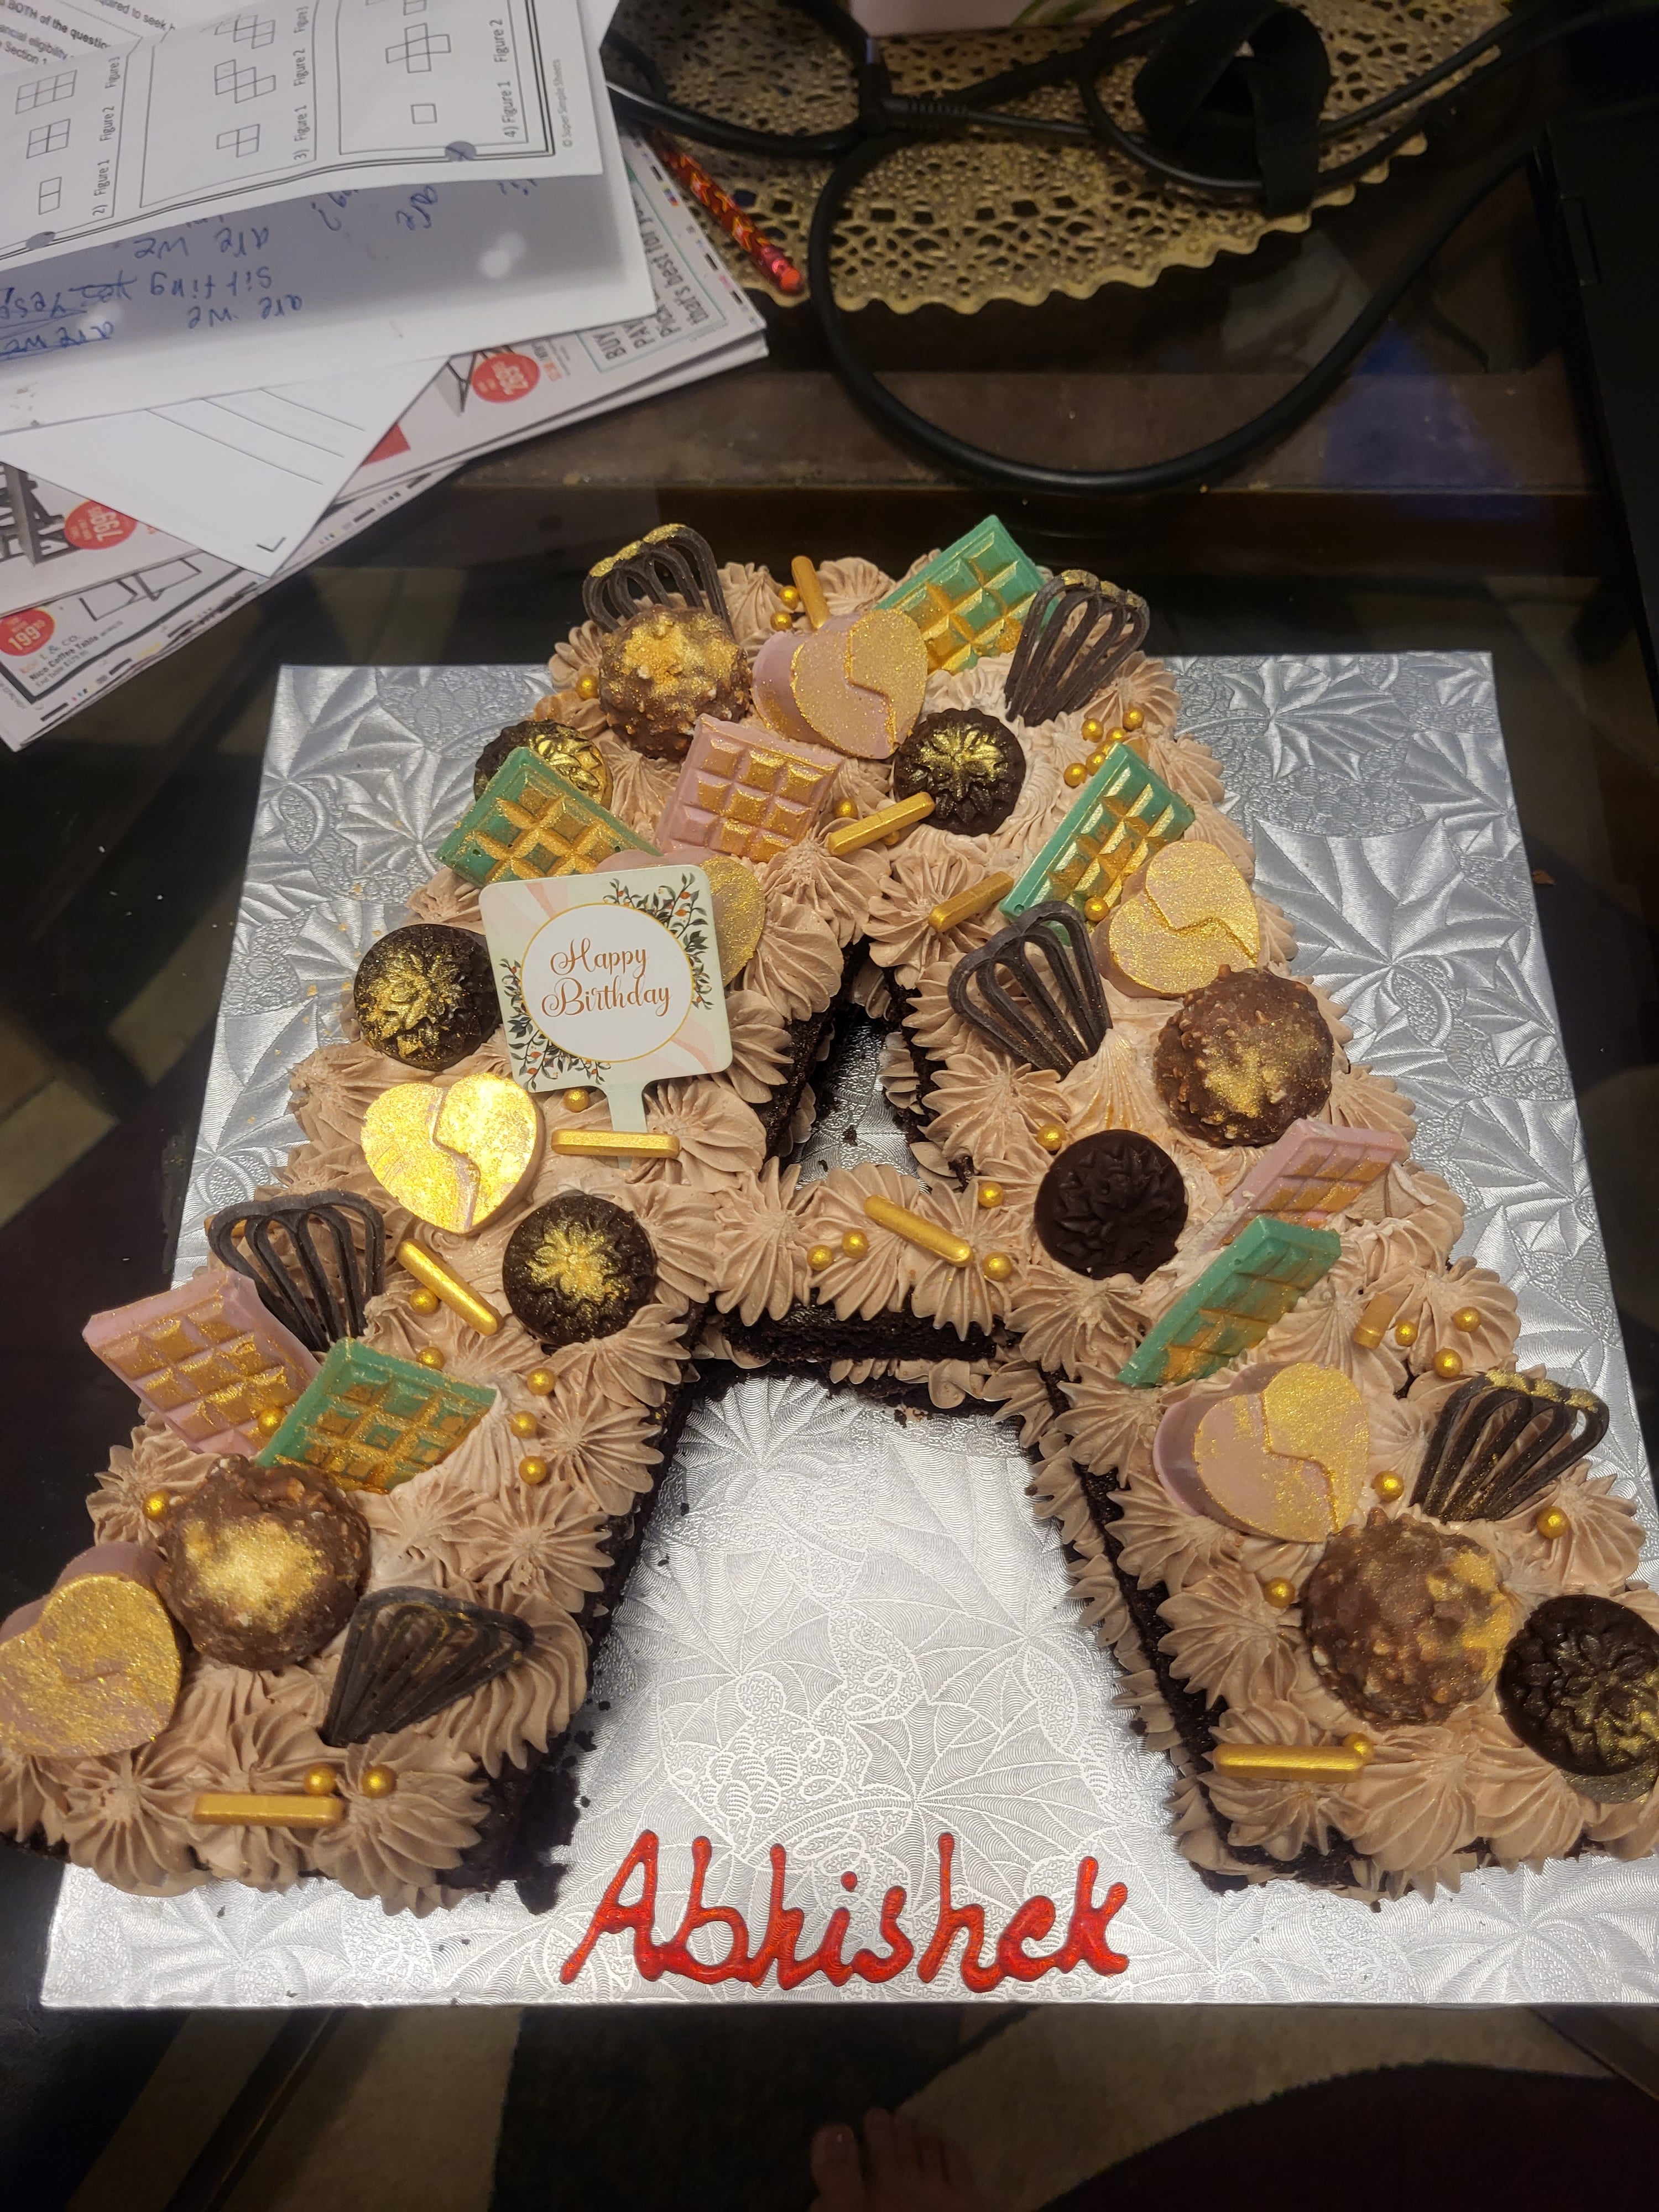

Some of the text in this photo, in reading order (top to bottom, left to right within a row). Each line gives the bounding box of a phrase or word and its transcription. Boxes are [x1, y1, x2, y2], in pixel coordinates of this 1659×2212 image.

[8, 0, 38, 19] BOTH
[40, 15, 51, 25] of
[53, 19, 67, 33] the
[132, 8, 141, 19] to
[143, 14, 166, 30] seek
[4, 41, 39, 65] Section
[489, 18, 509, 63] Figure 2
[105, 64, 121, 89] Figure
[293, 48, 309, 86] Figure 2
[502, 90, 518, 123] Figure
[557, 87, 568, 114] Simple
[99, 105, 116, 142] Figure 2
[294, 114, 310, 143] Figure
[503, 125, 519, 138] 4)
[293, 148, 309, 160] 3)
[93, 166, 110, 197] Figure
[92, 205, 108, 216] 2)
[215, 227, 269, 258] are
[650, 252, 684, 289] best
[258, 294, 302, 319] are
[592, 331, 627, 361] BUY
[622, 319, 655, 349] PAY
[550, 937, 650, 982] Happy
[541, 975, 672, 1019] Birthday
[560, 1828, 1129, 1992] Abhishek
